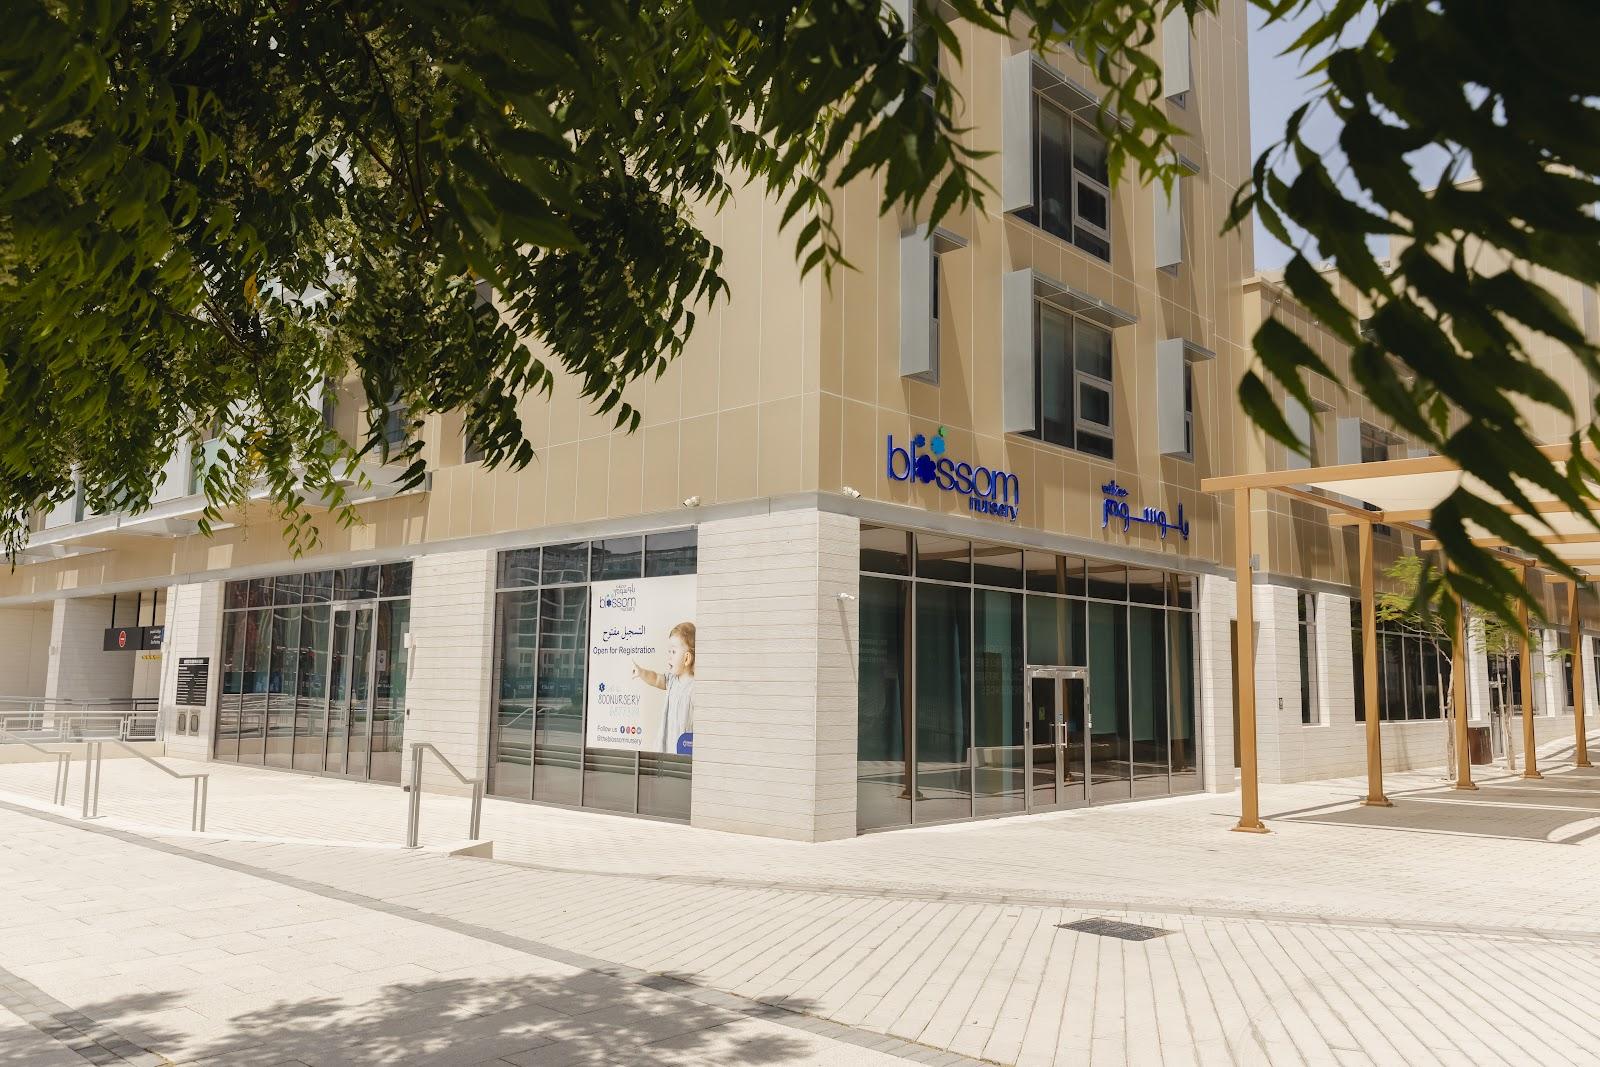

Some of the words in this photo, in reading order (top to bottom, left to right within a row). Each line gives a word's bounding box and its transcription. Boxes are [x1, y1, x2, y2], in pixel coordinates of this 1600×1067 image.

[887, 433, 1019, 506] blossom
[969, 496, 1018, 522] nursery
[1101, 498, 1189, 540] بلوسوم
[599, 596, 637, 609] blossom
[602, 626, 620, 642] مفتوح
[621, 624, 646, 641] التسجيل
[592, 646, 609, 655] Open
[609, 646, 618, 654] for
[618, 645, 656, 656] Registration
